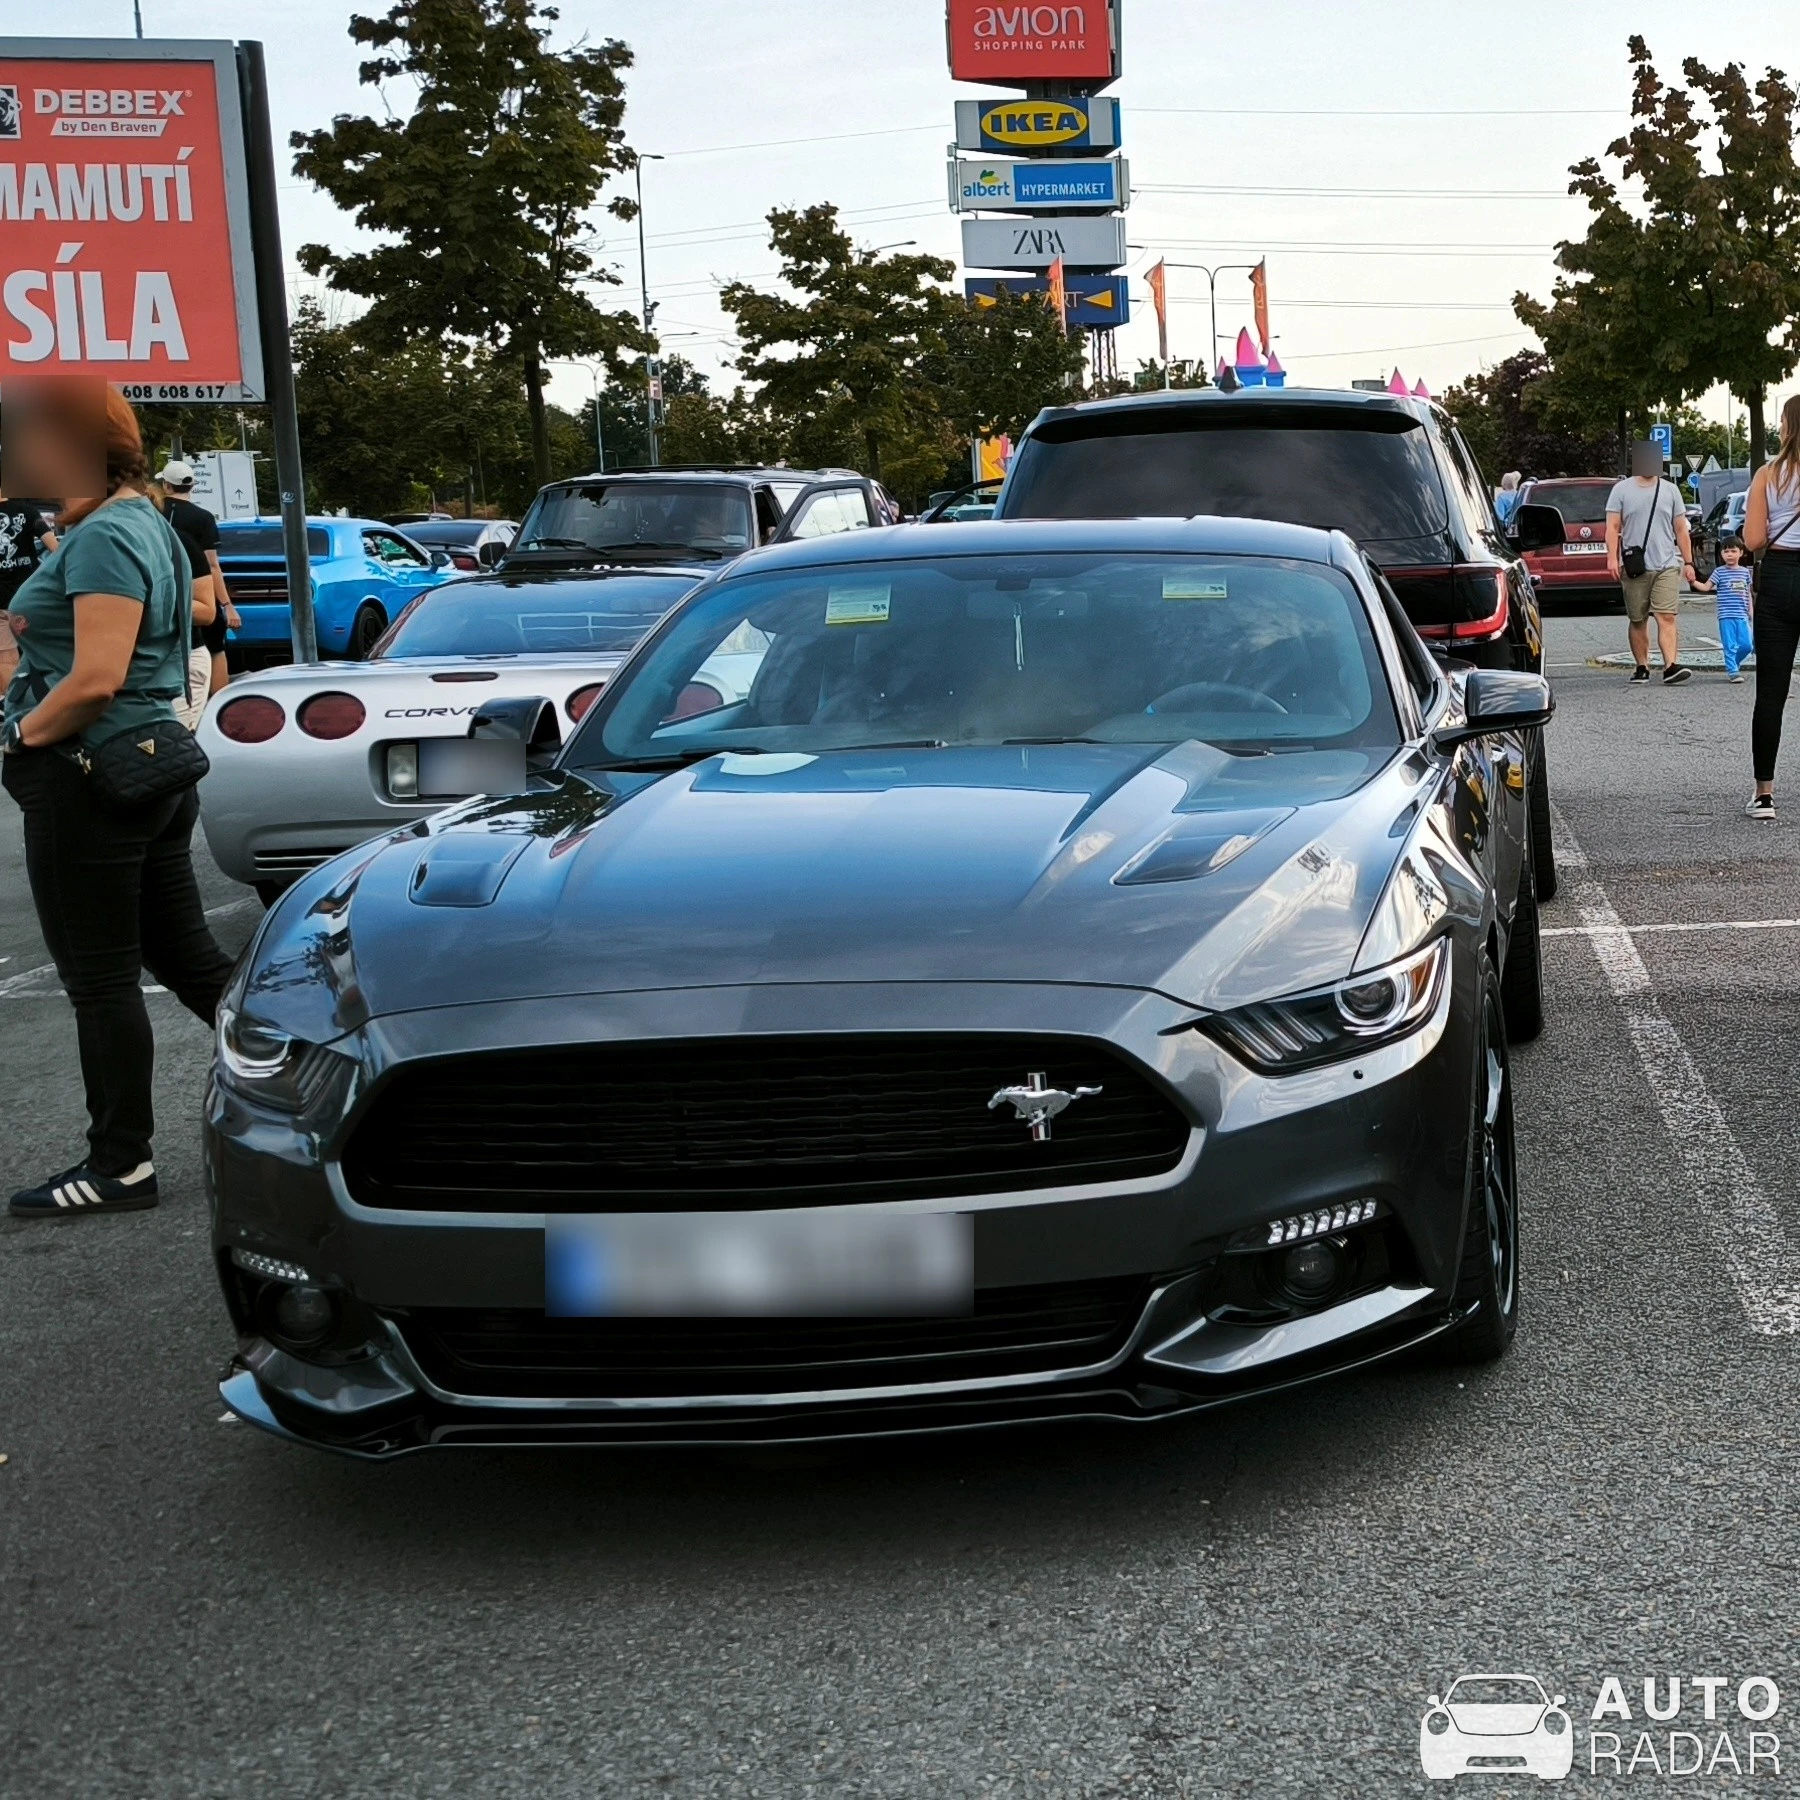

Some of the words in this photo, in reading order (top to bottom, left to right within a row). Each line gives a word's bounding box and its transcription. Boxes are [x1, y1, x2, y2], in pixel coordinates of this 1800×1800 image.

[974, 6, 1085, 37] avion
[974, 41, 1043, 51] SHOPPING
[1052, 41, 1085, 50] PARK
[62, 122, 77, 134] by
[81, 121, 107, 132] Den
[111, 122, 157, 133] Braven
[990, 112, 1080, 133] IKEA
[963, 182, 1010, 197] albert
[1021, 183, 1106, 196] HYPERMARKET
[1013, 229, 1066, 255] ZARA
[3, 242, 190, 362] SÍLA
[122, 385, 153, 399] 608
[159, 385, 189, 399] 608
[195, 385, 225, 399] 617
[1654, 428, 1667, 442] P
